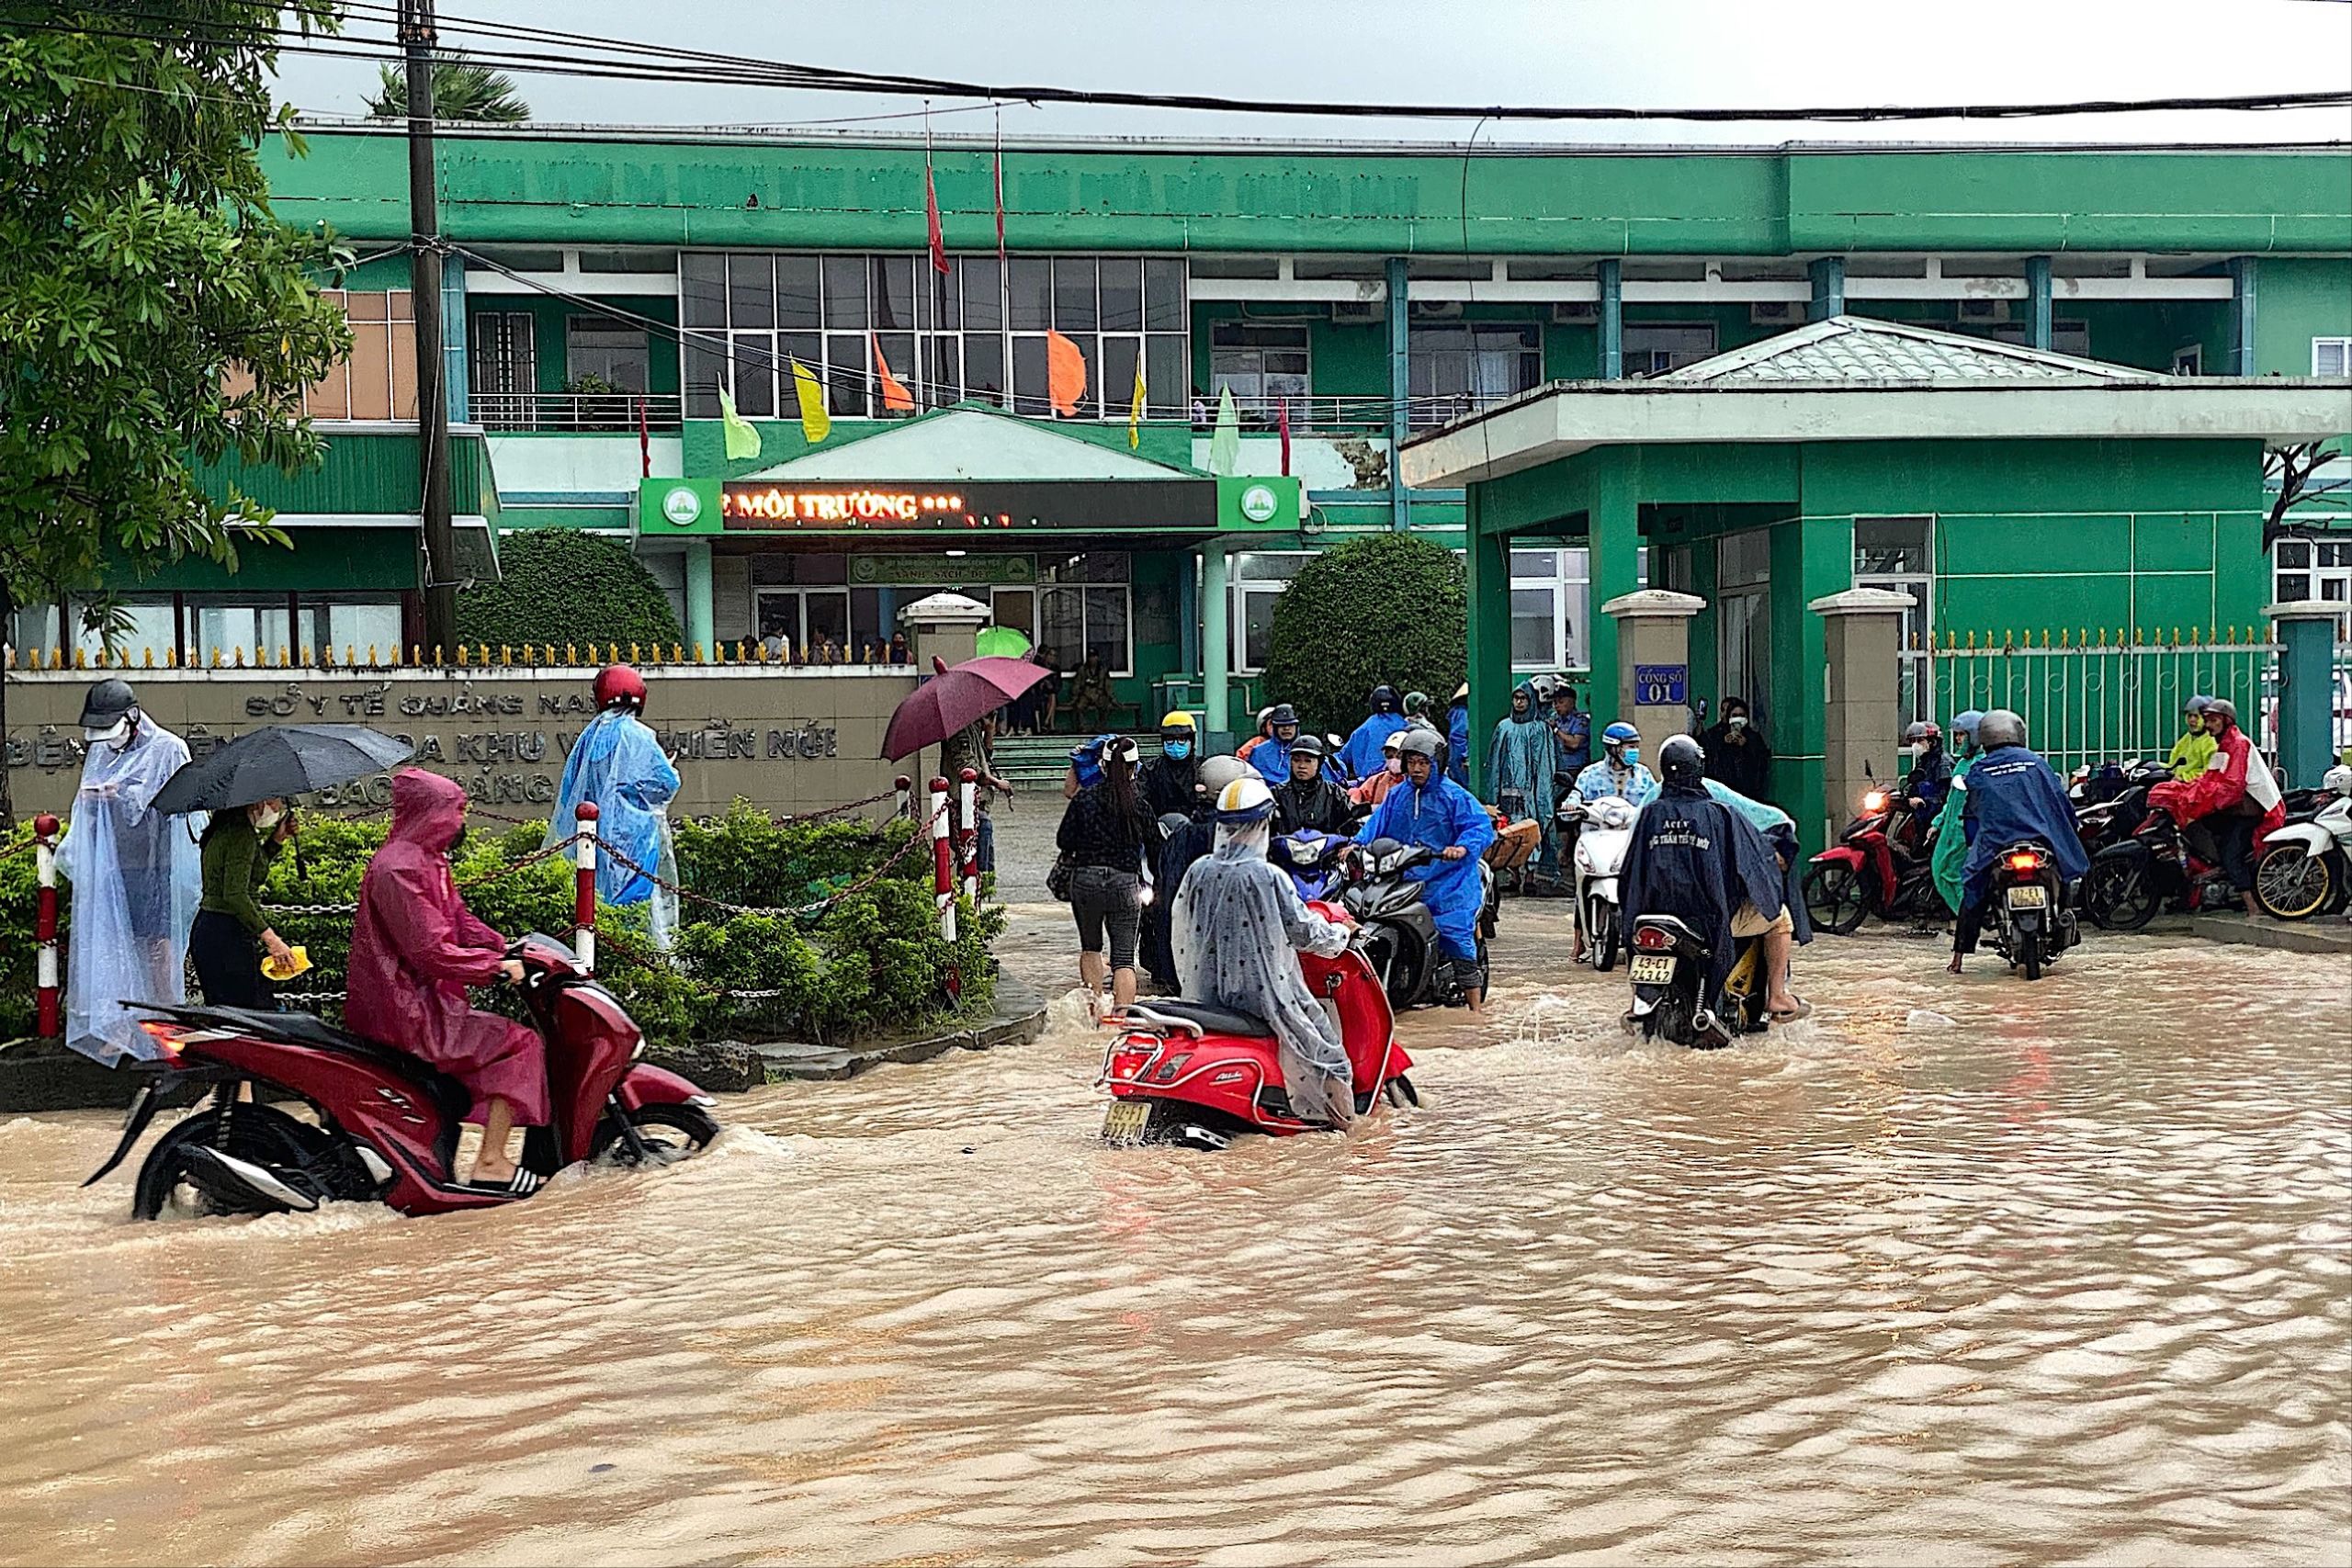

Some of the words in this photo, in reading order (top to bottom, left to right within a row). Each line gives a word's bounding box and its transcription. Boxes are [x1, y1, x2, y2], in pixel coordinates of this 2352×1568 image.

[739, 490, 795, 519] MÔI
[798, 491, 918, 520] TRƯỜNG
[246, 682, 303, 716] SỞ
[307, 695, 330, 716] Y
[339, 681, 392, 716] TẾ
[399, 681, 524, 716] QUẢNG
[538, 694, 598, 715] NA
[1648, 682, 1672, 703] 01
[458, 730, 545, 762] KHU
[658, 717, 756, 759] MIỀN
[767, 717, 837, 759] NÚI
[1638, 957, 1668, 969] 43-C1
[1630, 969, 1669, 983] 243.42
